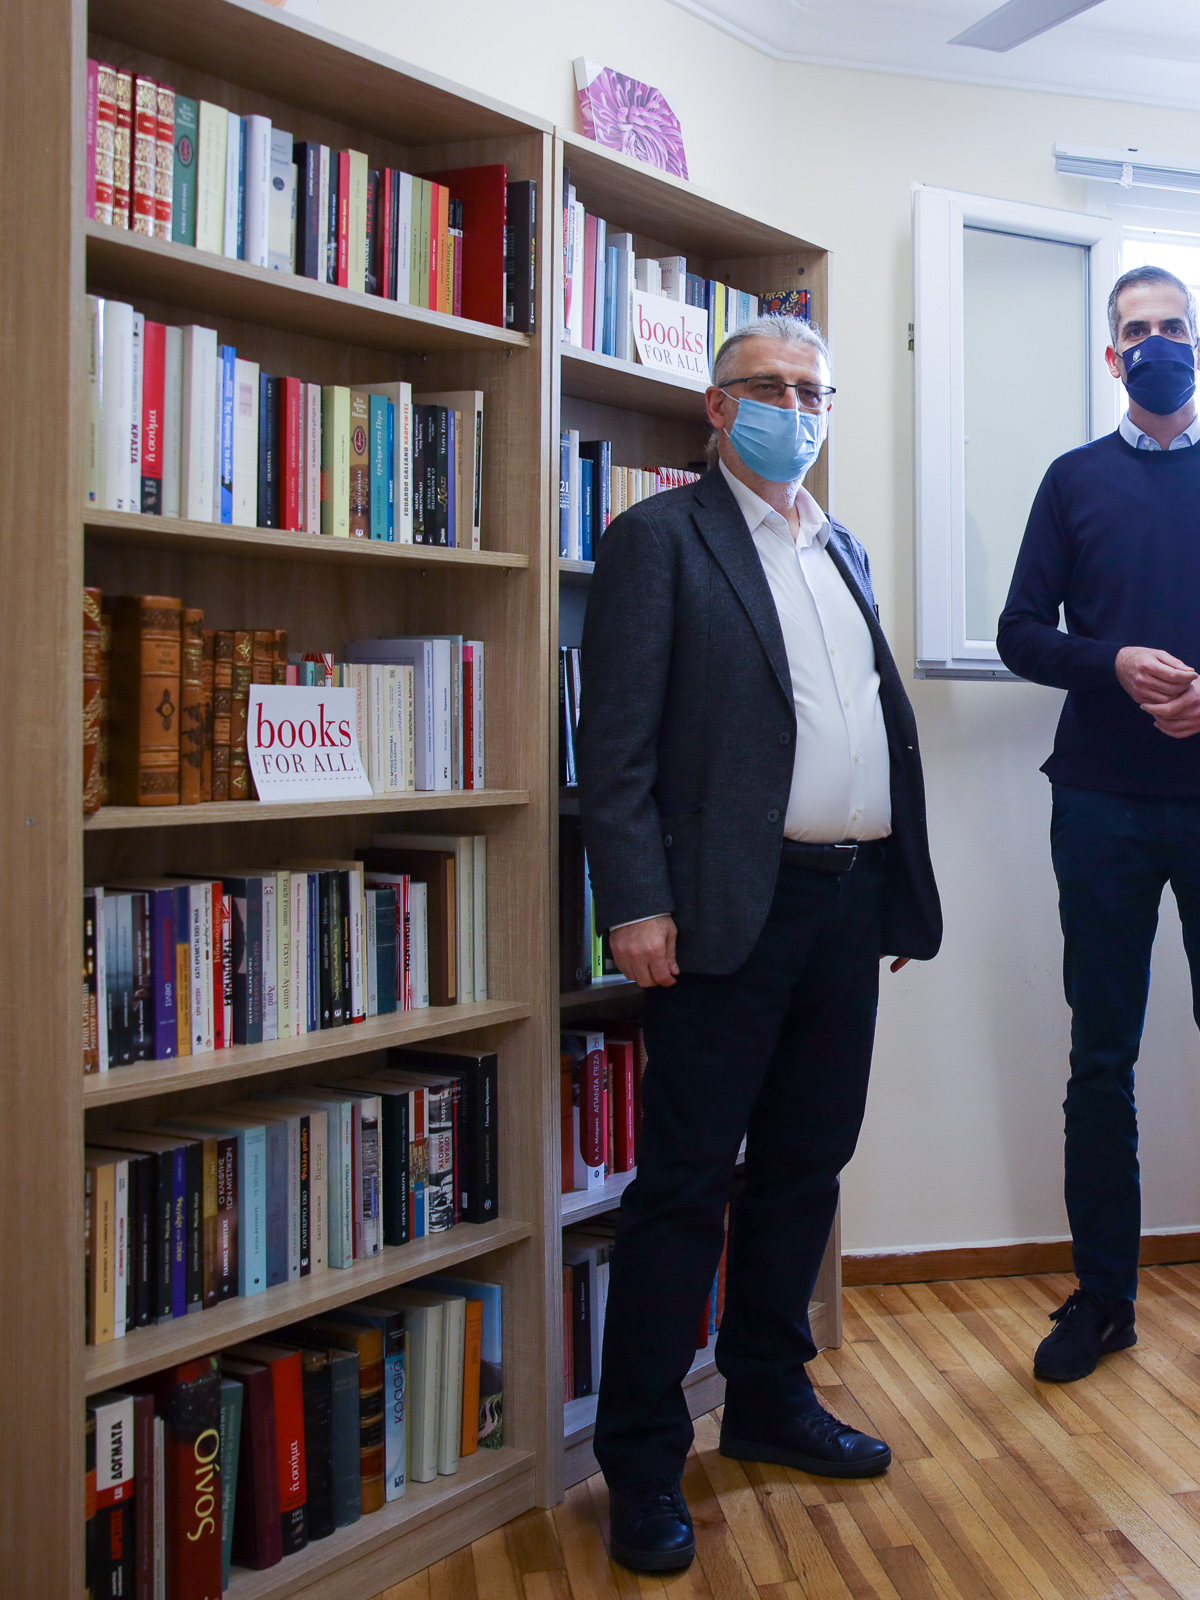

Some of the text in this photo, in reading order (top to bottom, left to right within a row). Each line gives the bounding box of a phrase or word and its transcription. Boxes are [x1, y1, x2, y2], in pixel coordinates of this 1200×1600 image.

[637, 304, 704, 355] books
[643, 344, 704, 374] FOR ALL
[254, 701, 352, 749] books
[261, 752, 354, 774] FOR ALL
